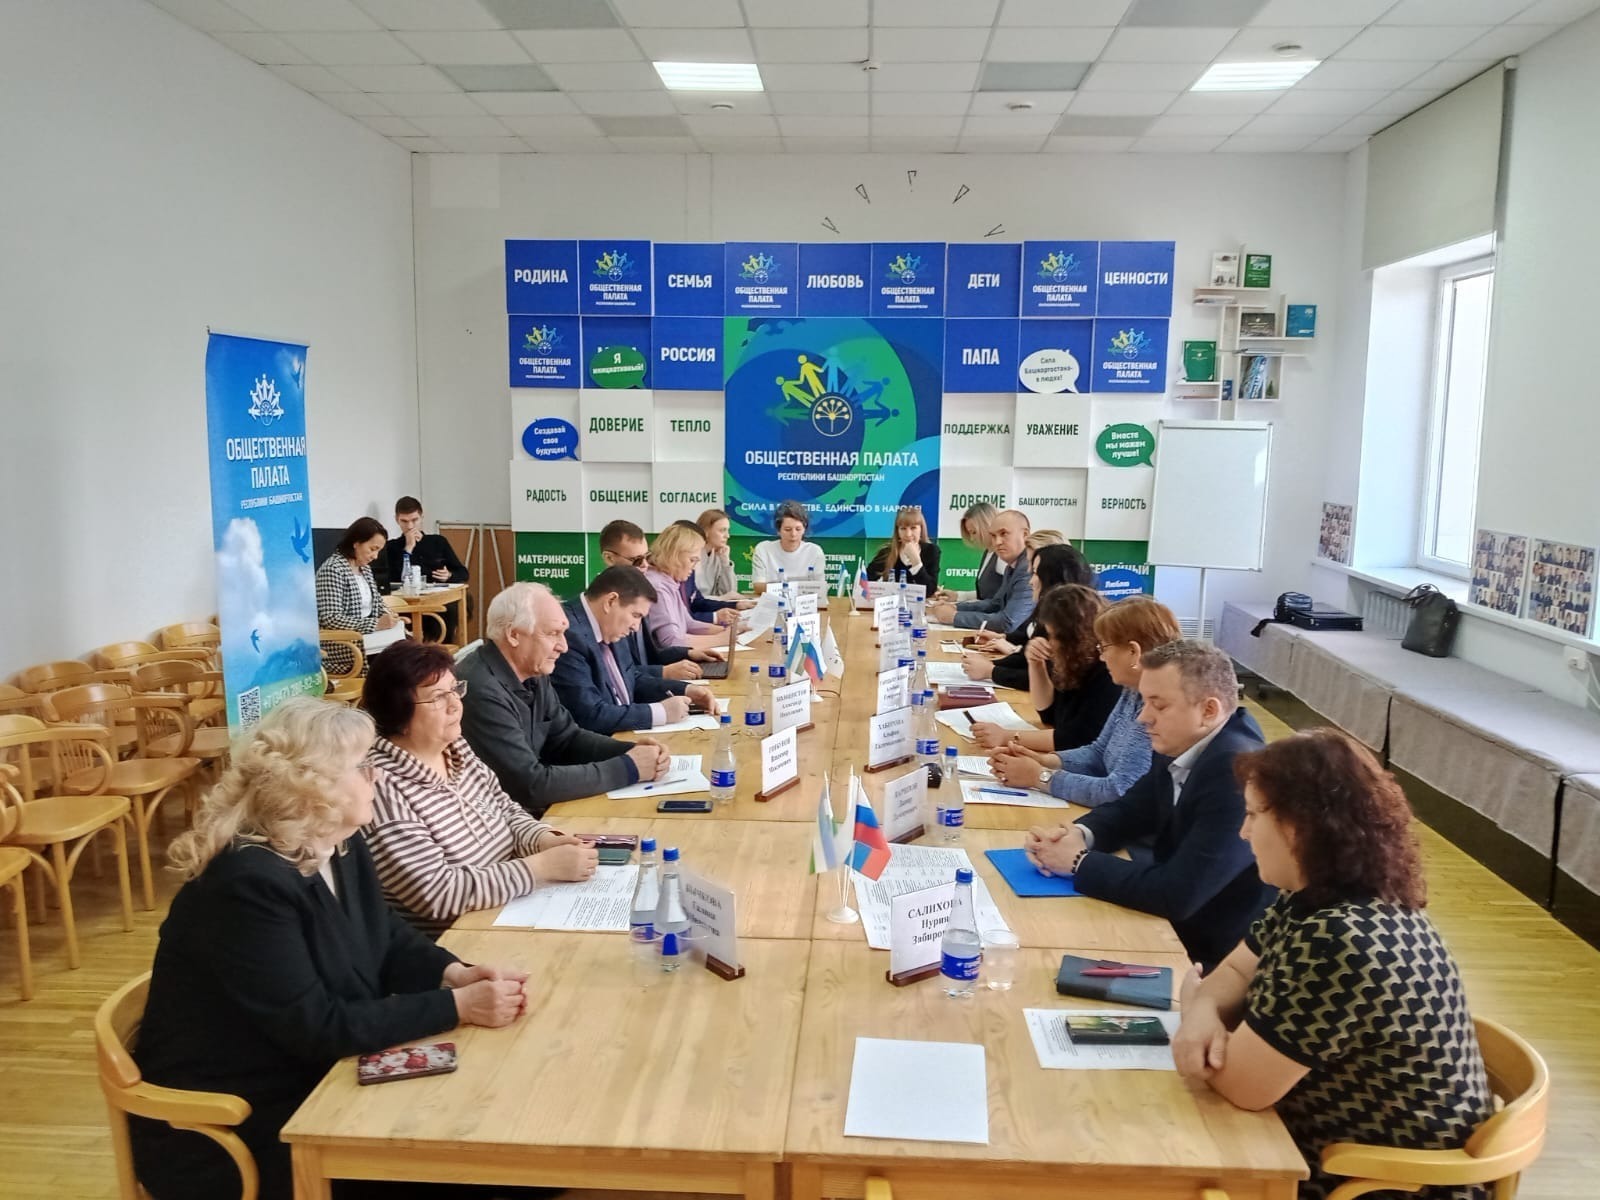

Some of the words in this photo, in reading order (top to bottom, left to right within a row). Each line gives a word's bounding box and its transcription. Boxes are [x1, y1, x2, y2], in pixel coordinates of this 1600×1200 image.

[514, 269, 568, 284] РОДИНА
[668, 274, 712, 288] СЕМЬЯ
[806, 274, 864, 289] ЛЮБОВЬ
[967, 274, 1000, 290] ДЕТИ
[1104, 272, 1168, 287] ЦЕННОСТИ
[589, 283, 642, 293] ОБЩЕСТВЕННАЯ
[735, 286, 788, 296] ОБЩЕСТВЕННАЯ
[881, 286, 935, 296] ОБЩЕСТВЕННАЯ
[1032, 284, 1088, 294] ОБЩЕСТВЕННАЯ
[603, 292, 628, 301] ПАЛАТА
[748, 295, 774, 303] ПАЛАТА
[894, 295, 920, 304] ПАЛАТА
[1046, 293, 1072, 303] ПАЛАТА
[613, 352, 622, 364] Я
[660, 347, 715, 362] РОССИЯ
[962, 348, 1000, 365] ПАПА
[519, 357, 572, 367] ОБЩЕСТВЕННАЯ
[1040, 357, 1056, 365] Сила
[1102, 361, 1158, 371] ОБЩЕСТВЕННАЯ
[533, 366, 557, 375] ПАЛАТА
[1116, 370, 1143, 379] ПАЛАТА
[534, 425, 566, 435] Создавай
[589, 416, 644, 434] ДОВЕРИЕ
[670, 420, 711, 432] ТЕПЛО
[944, 423, 1010, 435] ПОДДЕРЖКА
[1026, 423, 1079, 436] УВАЖЕНИЕ
[1111, 431, 1139, 440] Вместе
[226, 435, 305, 463] ОБЩЕСТВЕННАЯ
[535, 446, 567, 456] будущее!
[1105, 442, 1118, 450] мы
[745, 450, 859, 467] ОБЩЕСТВЕННАЯ
[863, 451, 919, 467] ПАЛАТА
[1111, 449, 1140, 460] лучше!
[250, 465, 290, 489] ПАЛАТА
[777, 472, 825, 481] РЕСПУБЛИКИ
[826, 473, 885, 482] БАШКОРТОСТАН
[526, 488, 567, 503] РАДОСТЬ
[589, 489, 649, 504] ОБЩЕНИЕ
[659, 491, 718, 504] СОГЛАСИЕ
[1018, 497, 1078, 507] БАШКОРТОСТАН
[1101, 497, 1147, 510] ВЕРНОСТЬ
[741, 503, 767, 511] СИЛА
[825, 504, 873, 513] ЕДИНСТВО
[874, 505, 880, 513] В
[518, 553, 585, 566] МАТЕРИНСКОЕ
[533, 567, 570, 579] СЕРДЦЕ
[945, 568, 980, 577] ОТКРЫТ
